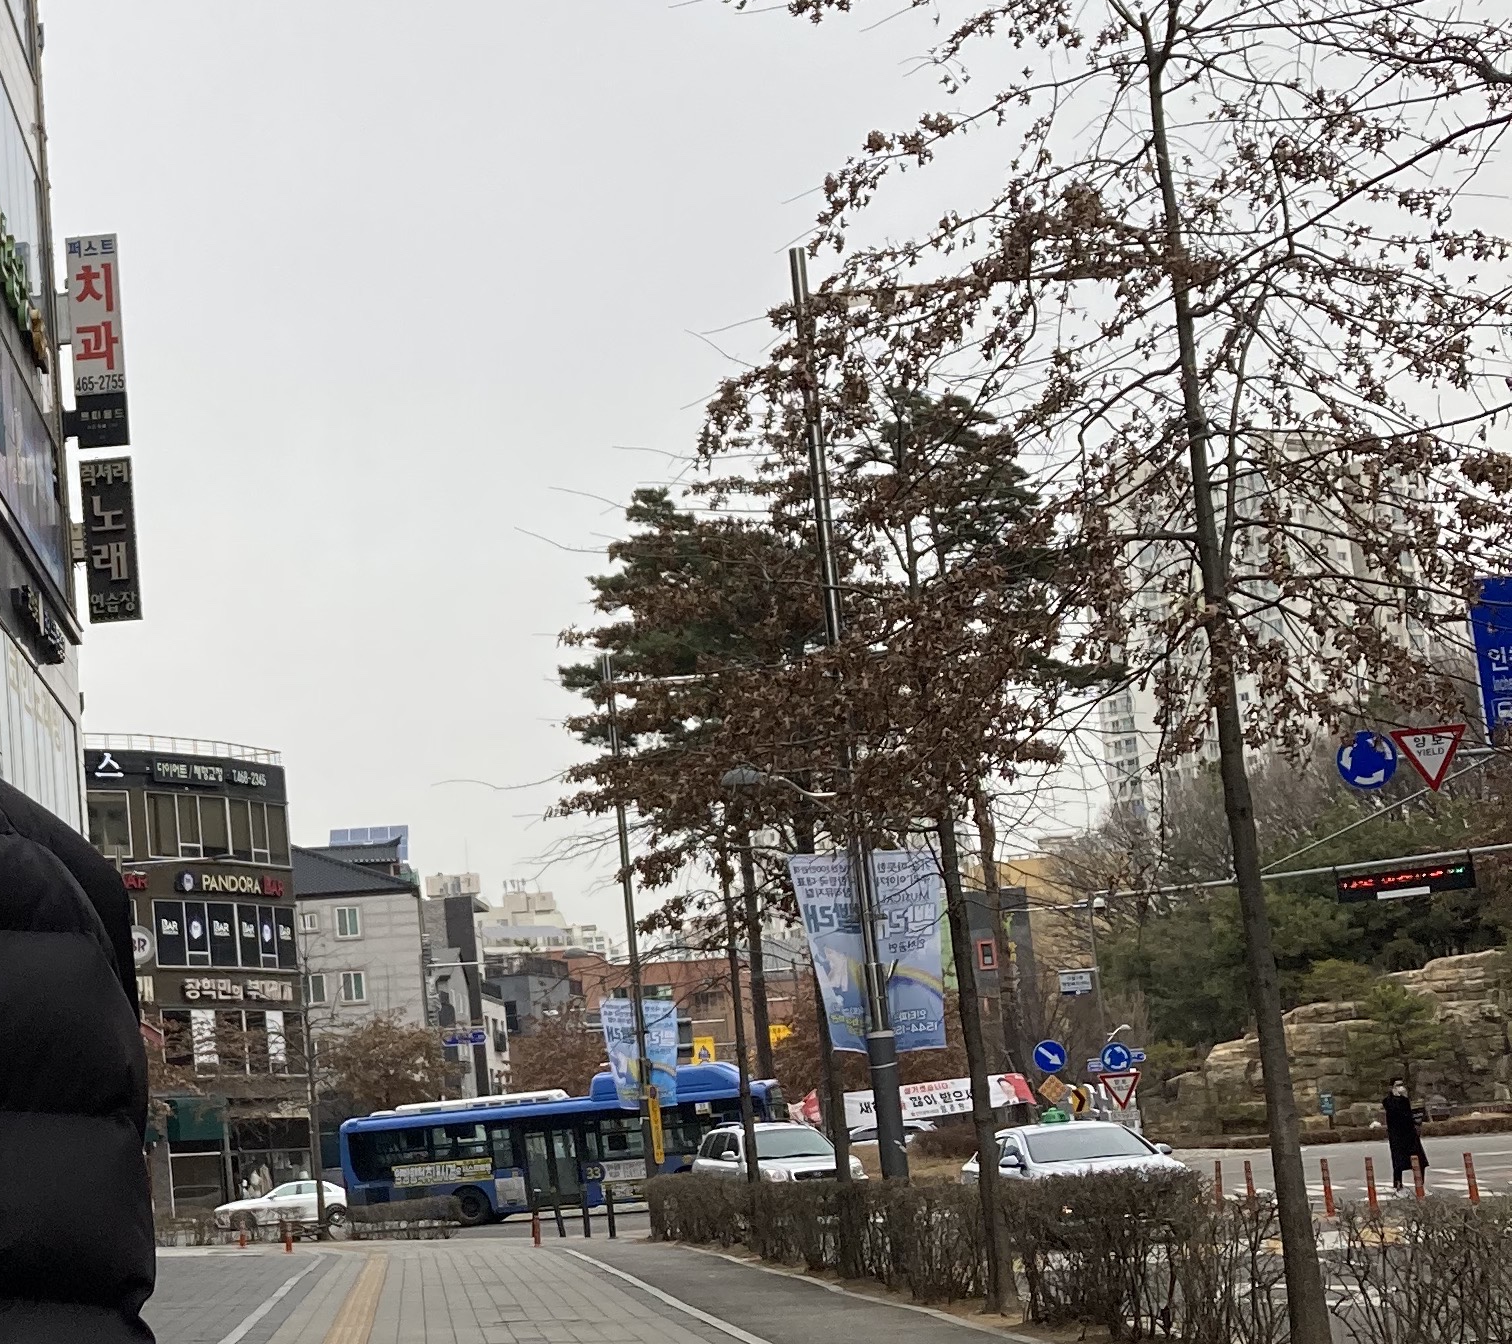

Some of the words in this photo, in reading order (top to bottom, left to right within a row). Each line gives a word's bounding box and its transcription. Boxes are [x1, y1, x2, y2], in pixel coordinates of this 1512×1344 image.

[75, 262, 120, 370] 치과
[75, 373, 125, 394] 465-2755
[80, 462, 130, 485] 럭셔리
[90, 494, 129, 581] 노래
[91, 590, 138, 614] 연습장
[1416, 747, 1446, 757] YIELD
[202, 874, 261, 895] PANDORA
[262, 875, 285, 897] BAR
[161, 918, 179, 931] BAR
[213, 920, 230, 932] BAR
